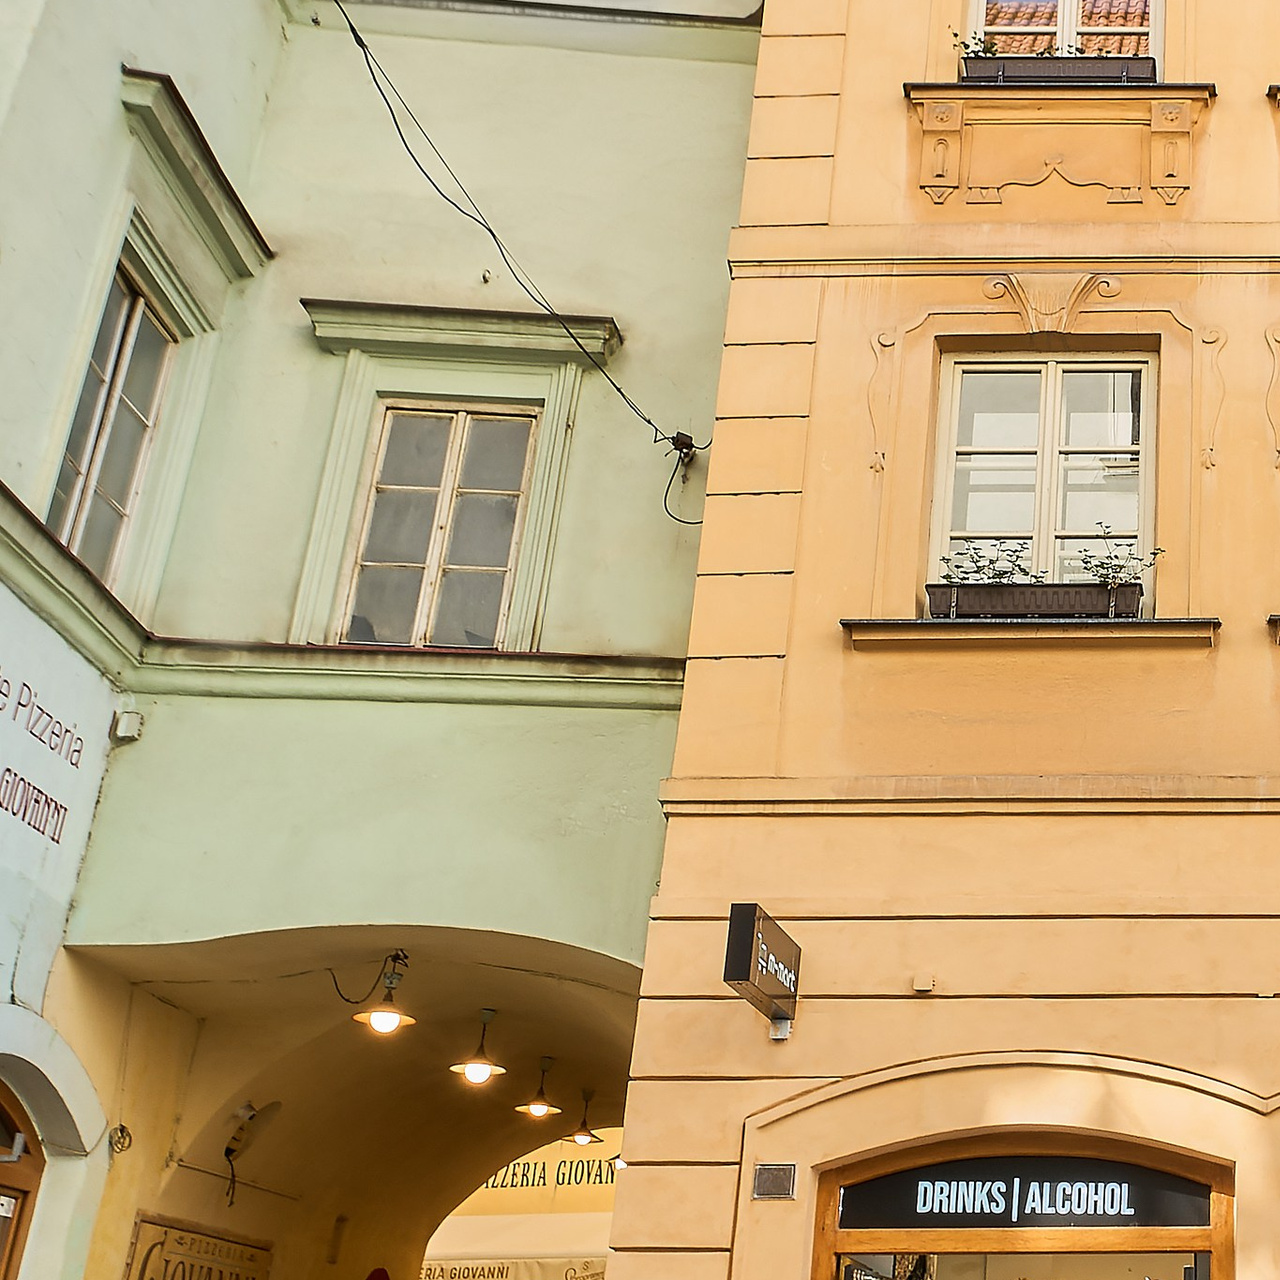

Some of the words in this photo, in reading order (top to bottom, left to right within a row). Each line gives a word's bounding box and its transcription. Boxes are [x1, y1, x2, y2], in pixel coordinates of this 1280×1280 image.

[13, 681, 84, 770] Pizzeria
[484, 1160, 547, 1189] ZZERIA
[556, 1158, 615, 1187] GIOVAN
[916, 1181, 1007, 1215] DRINKS
[1024, 1181, 1135, 1216] ALCOHOL
[418, 1267, 445, 1280] ERIA
[449, 1266, 509, 1279] GIOVANNI
